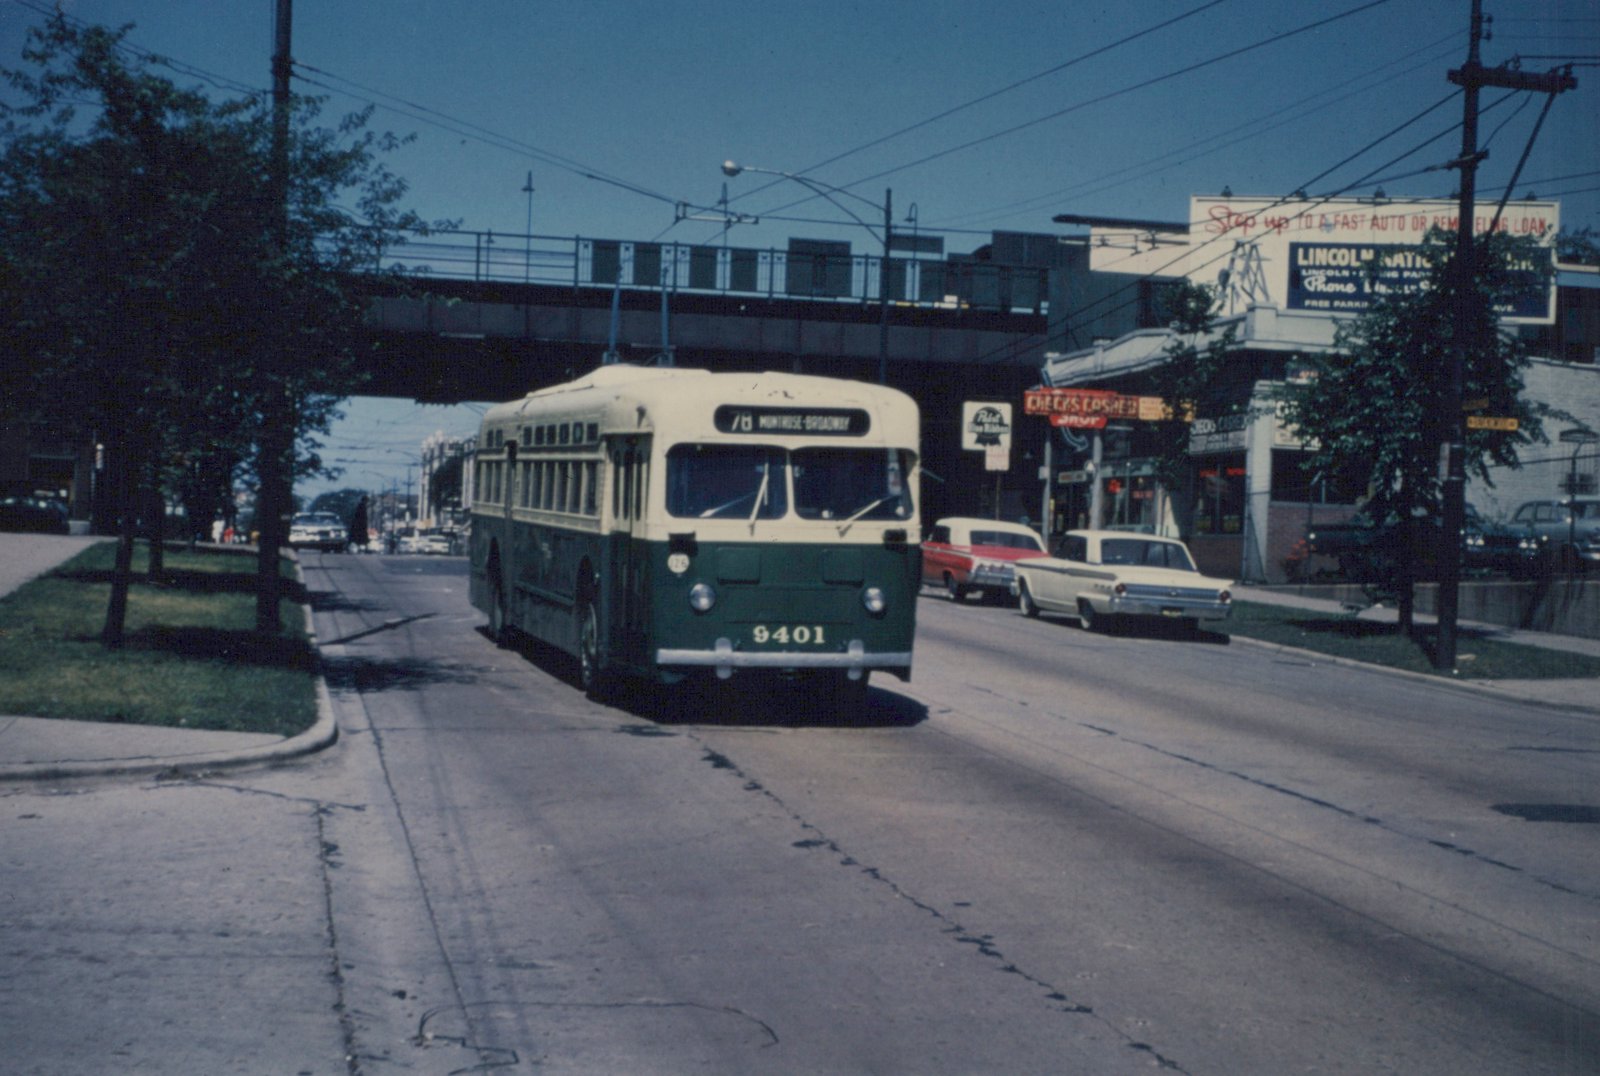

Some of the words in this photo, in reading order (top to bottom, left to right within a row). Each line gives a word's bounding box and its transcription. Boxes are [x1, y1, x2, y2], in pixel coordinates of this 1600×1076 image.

[1205, 205, 1256, 236] Step
[1264, 214, 1290, 235] up
[1298, 213, 1313, 229] TO
[1334, 214, 1366, 230] FAST
[1370, 214, 1405, 231] AUTO
[1411, 215, 1427, 231] OR
[1297, 247, 1374, 267] LINCOLN
[1301, 269, 1349, 277] LINCOLN
[1304, 275, 1356, 294] Phone
[1304, 300, 1330, 308] FREE
[1492, 304, 1516, 312] AVE.
[752, 625, 825, 644] 9401
